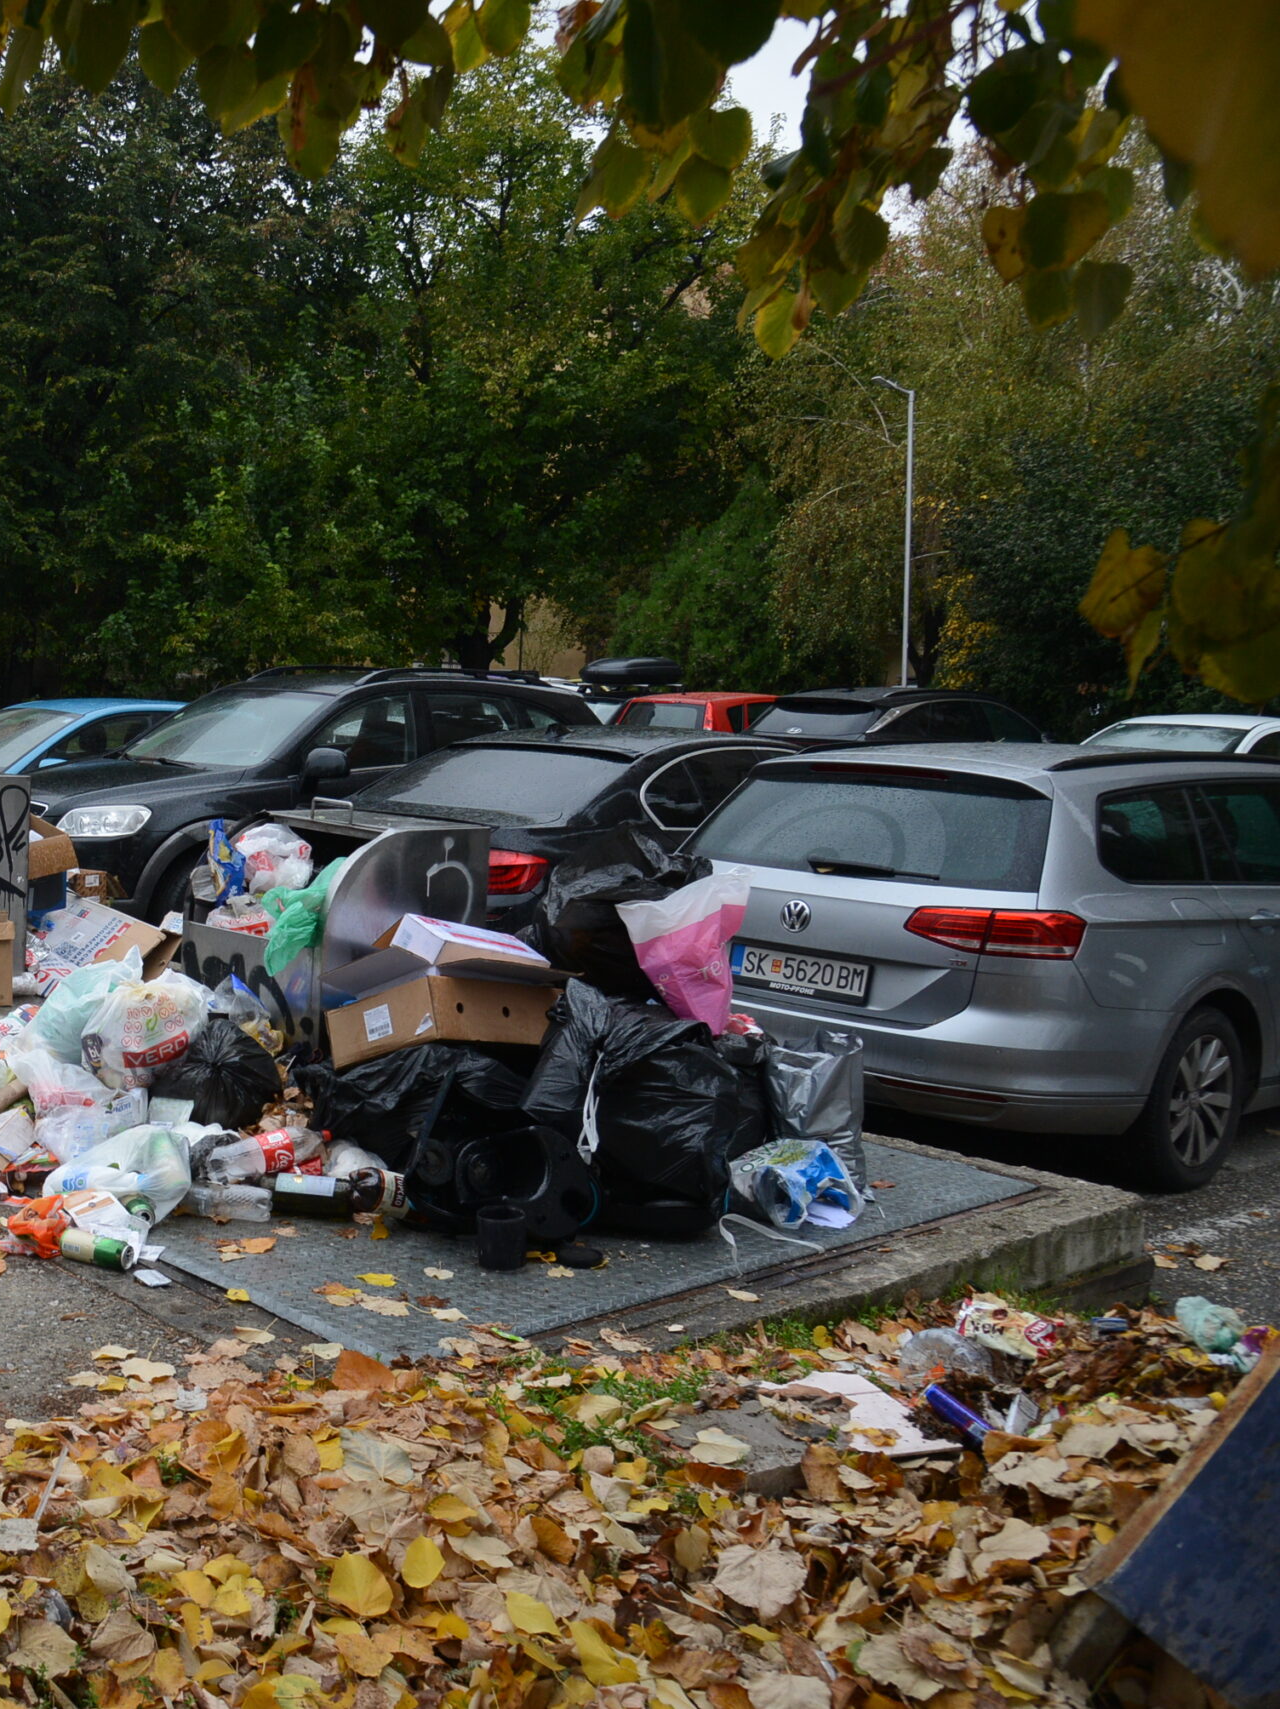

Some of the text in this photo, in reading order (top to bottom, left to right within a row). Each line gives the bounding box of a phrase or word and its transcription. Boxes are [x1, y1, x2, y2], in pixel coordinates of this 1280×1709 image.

[744, 951, 866, 993] SK 5620 BM
